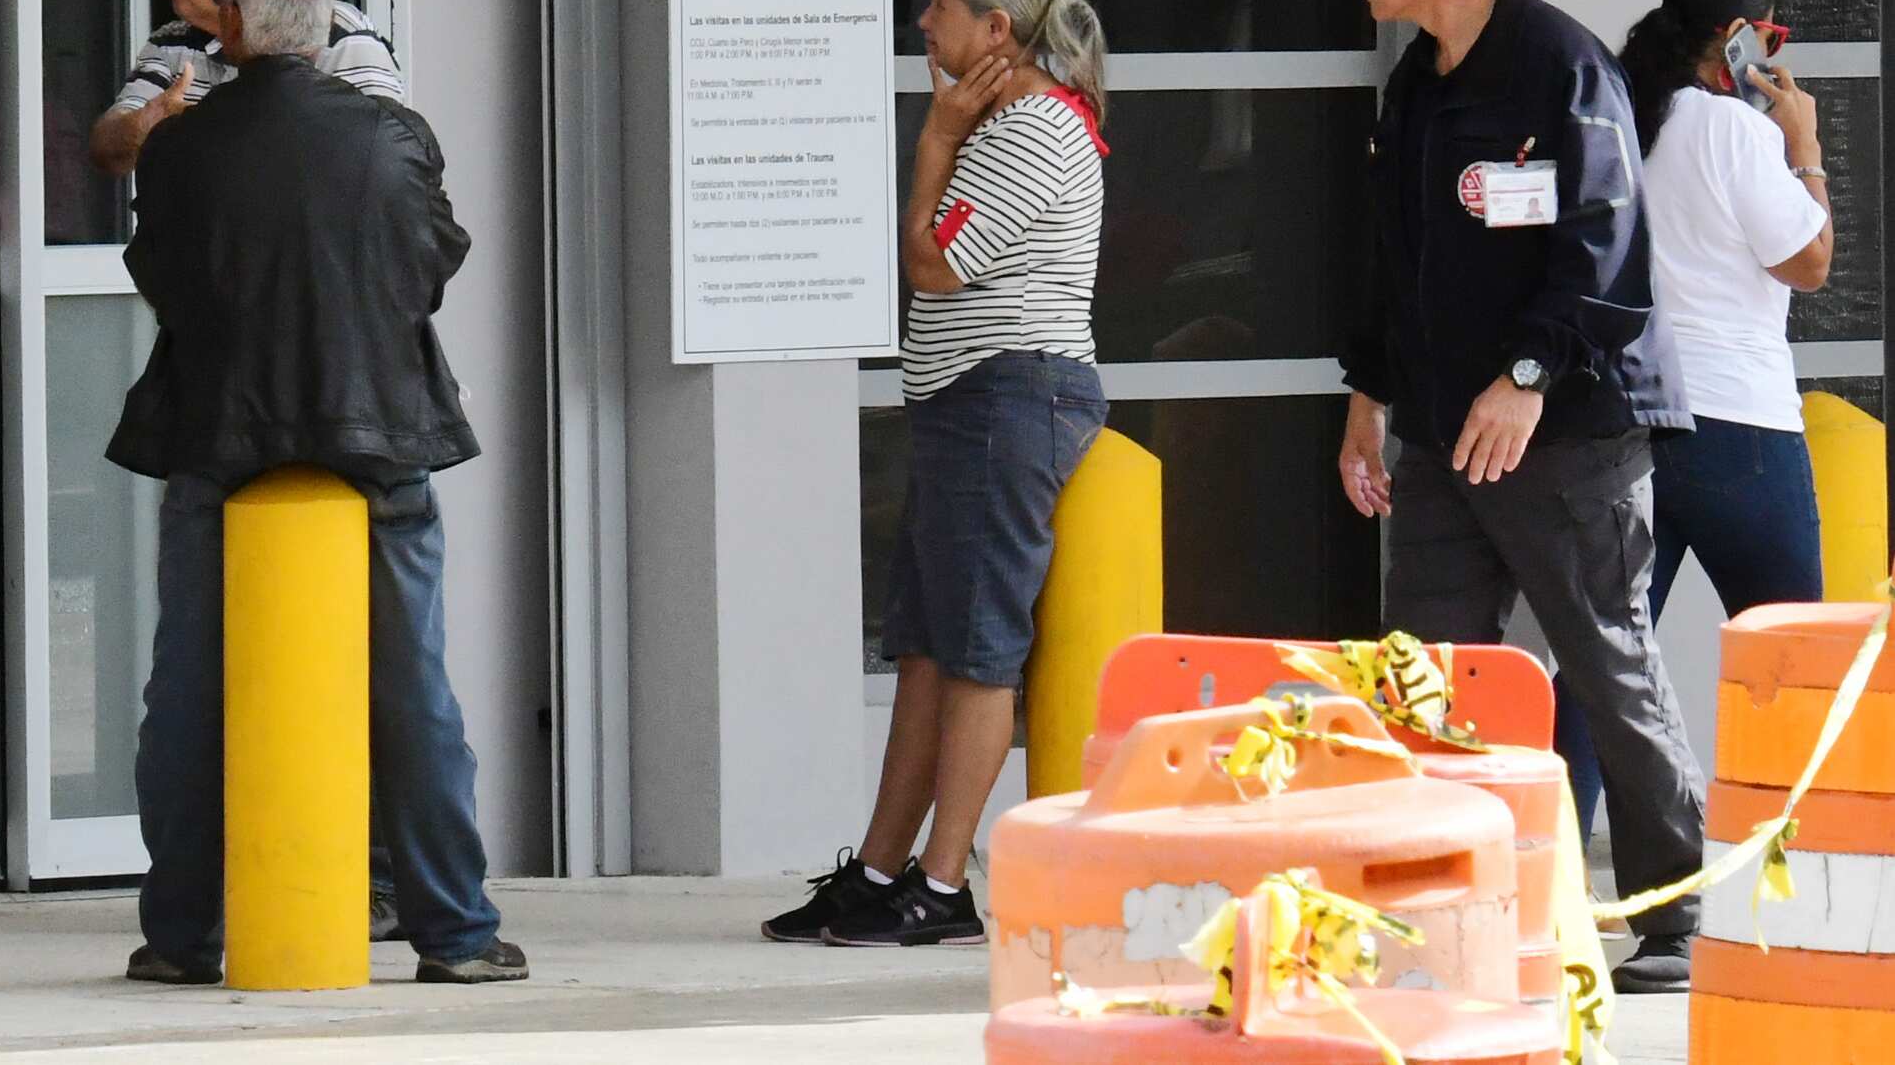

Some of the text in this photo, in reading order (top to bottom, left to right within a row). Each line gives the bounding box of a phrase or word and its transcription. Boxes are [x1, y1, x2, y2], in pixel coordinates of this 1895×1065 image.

[689, 13, 878, 26] Las visitas en las unidades de Sala de Emergencia
[691, 152, 834, 165] Las visitas en las unidades de Trauma
